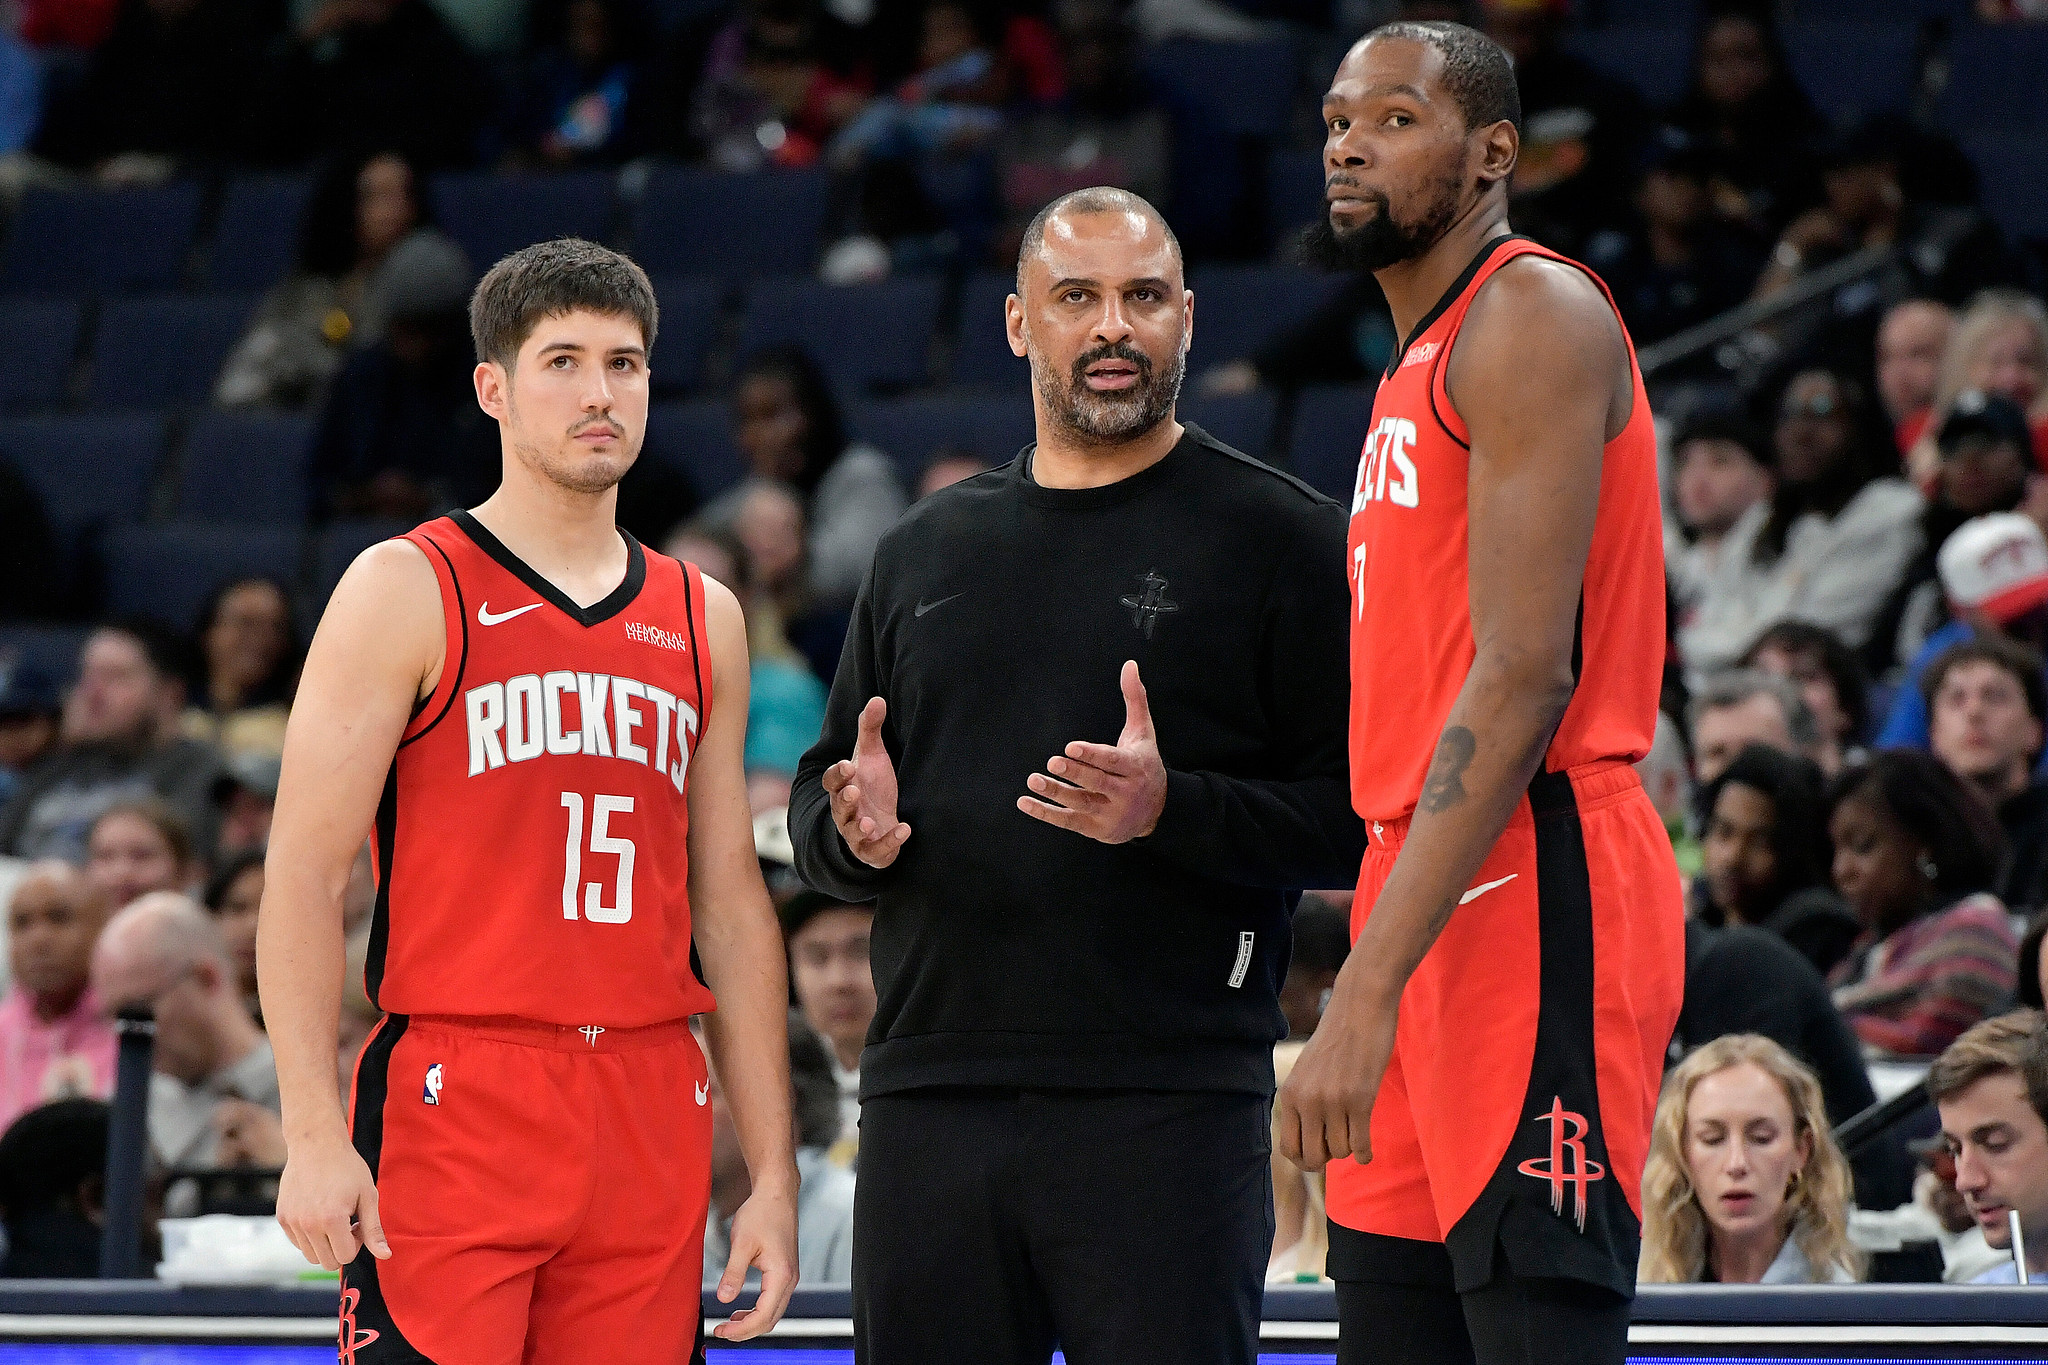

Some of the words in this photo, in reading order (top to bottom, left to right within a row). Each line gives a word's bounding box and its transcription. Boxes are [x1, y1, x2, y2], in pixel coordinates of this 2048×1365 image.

[1353, 541, 1366, 624] 7
[624, 621, 685, 643] MEMORIAL
[626, 630, 686, 652] HERMANN
[465, 670, 698, 795] ROCKETS
[560, 791, 636, 925] 15
